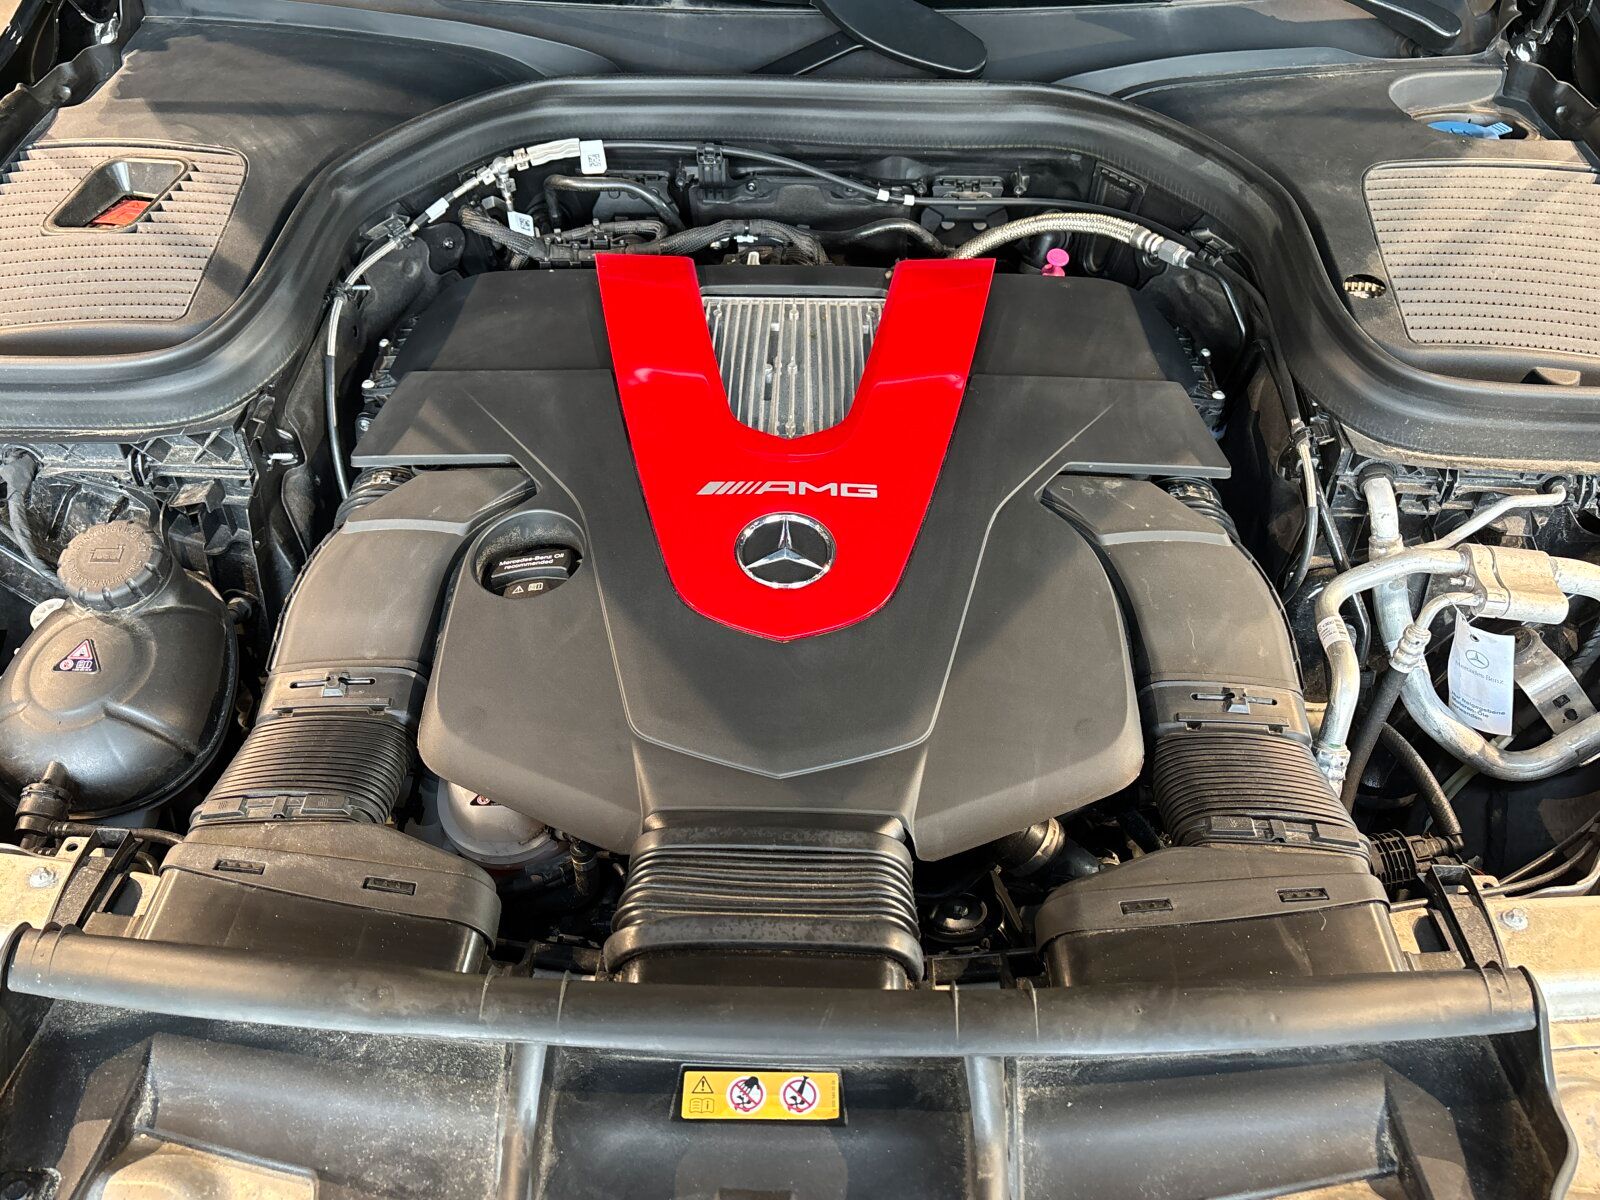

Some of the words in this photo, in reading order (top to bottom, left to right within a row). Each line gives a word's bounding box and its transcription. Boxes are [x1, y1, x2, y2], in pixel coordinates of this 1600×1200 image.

[754, 480, 878, 499] AMG
[498, 554, 553, 567] Mercedes-Benz
[504, 559, 554, 570] recommended
